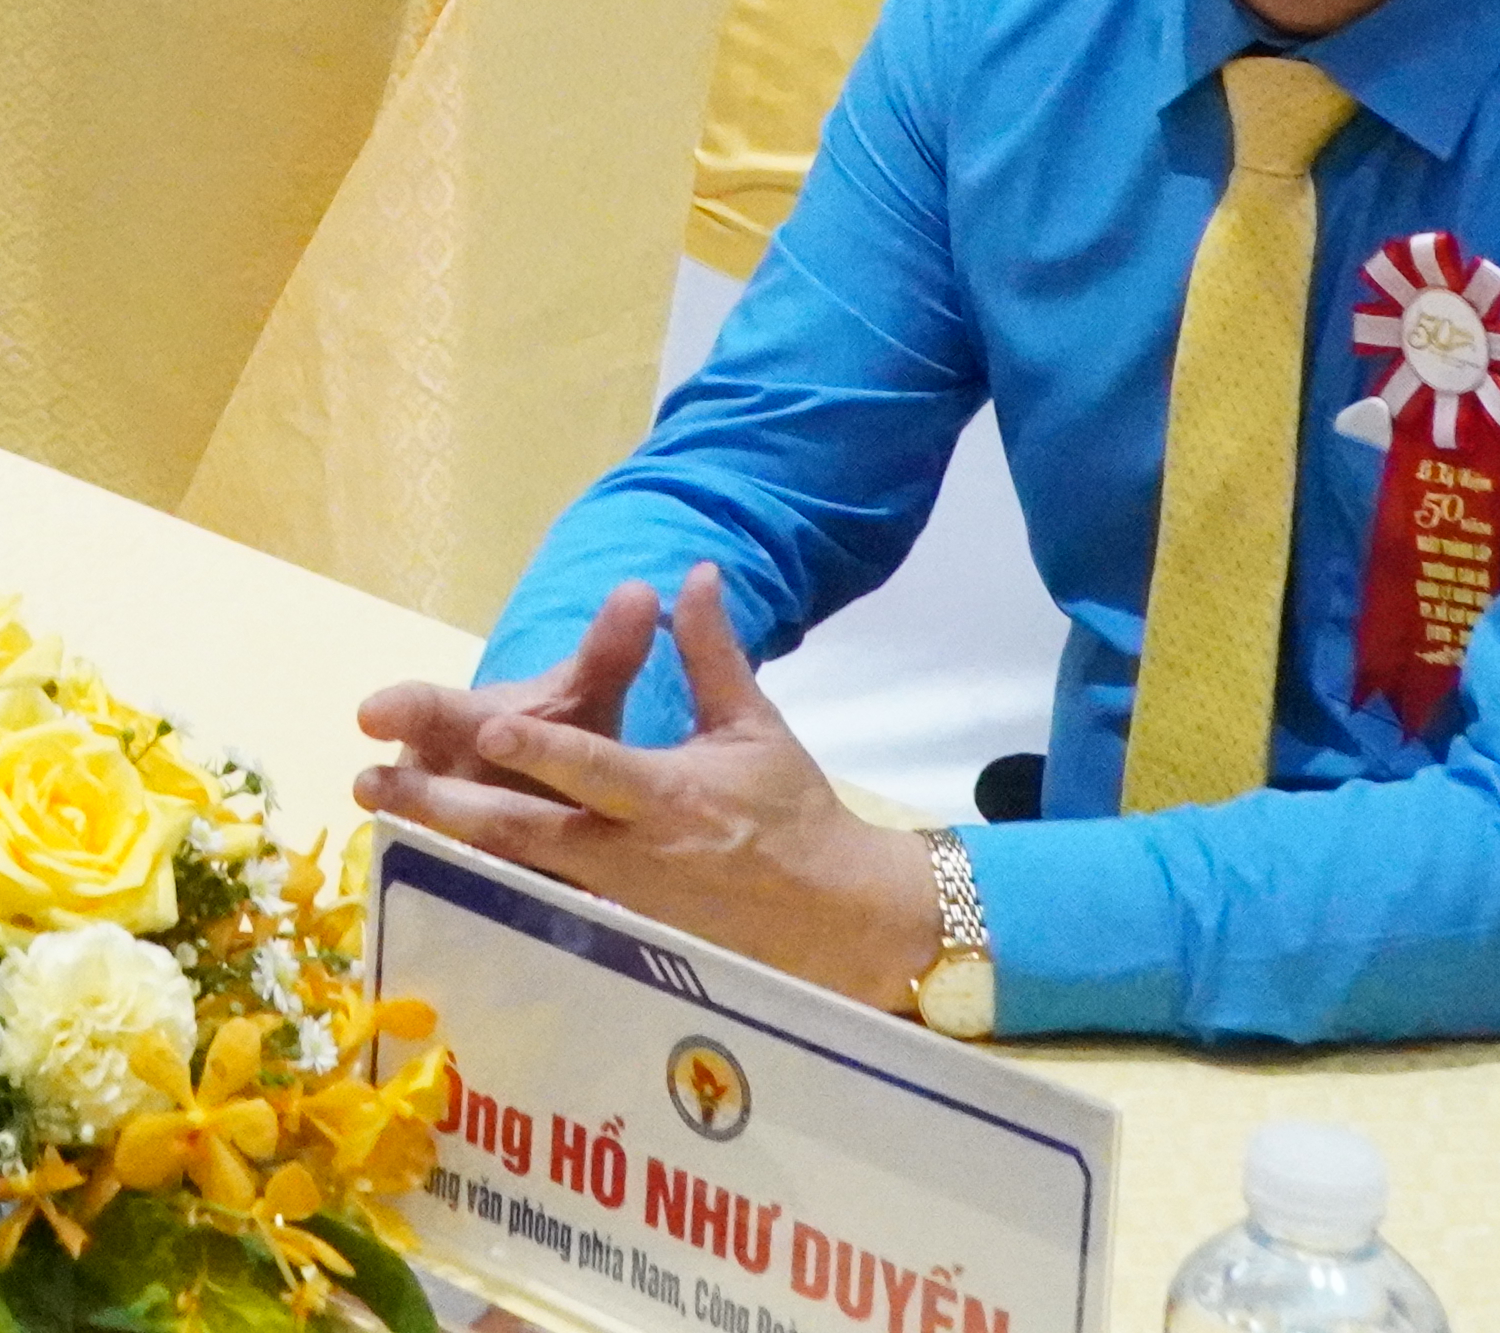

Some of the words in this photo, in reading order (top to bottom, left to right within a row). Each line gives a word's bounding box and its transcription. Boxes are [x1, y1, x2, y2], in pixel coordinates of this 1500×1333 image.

[467, 1173, 503, 1225] văn
[508, 1195, 573, 1263] phòng
[578, 1228, 625, 1284] phía
[630, 1245, 687, 1318] Nam,
[550, 1113, 628, 1210] HỒ
[644, 1156, 783, 1275] NHƯ
